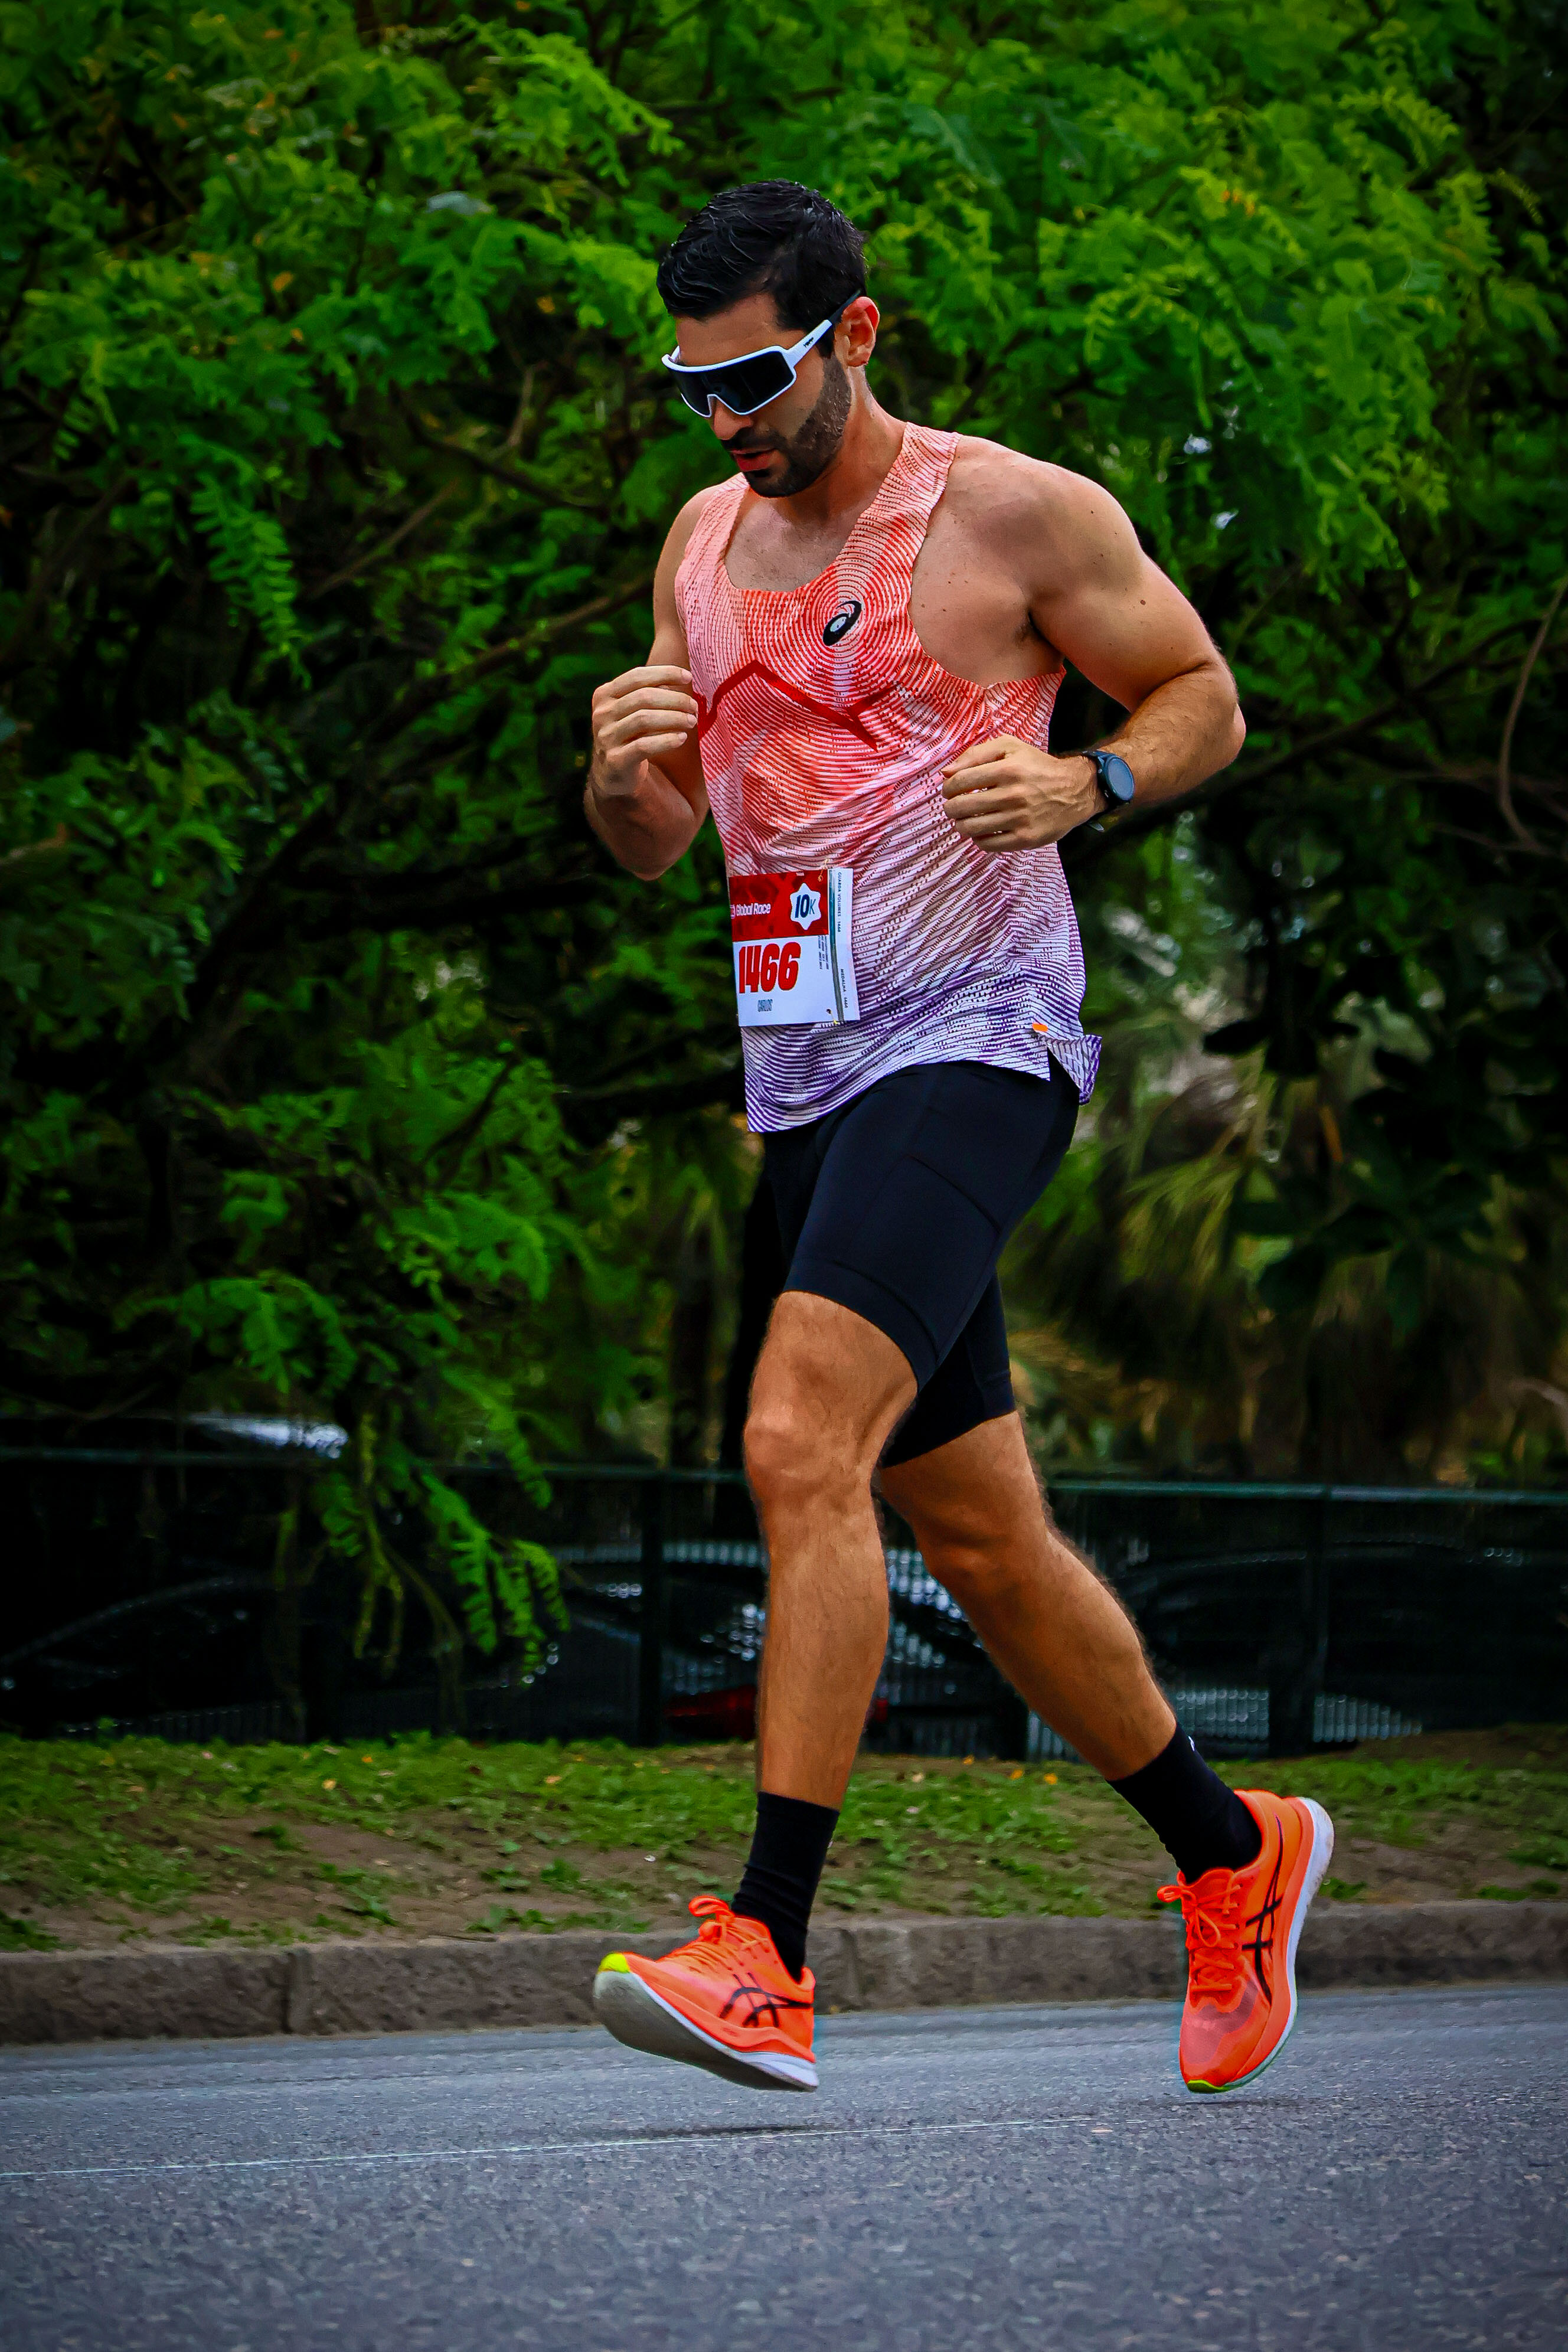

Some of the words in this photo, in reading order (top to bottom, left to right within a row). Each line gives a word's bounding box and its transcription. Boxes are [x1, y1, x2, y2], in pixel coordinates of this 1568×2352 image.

[736, 903, 753, 916] Global
[753, 903, 770, 914] Race
[795, 894, 816, 918] 10K
[739, 942, 801, 994] 1466
